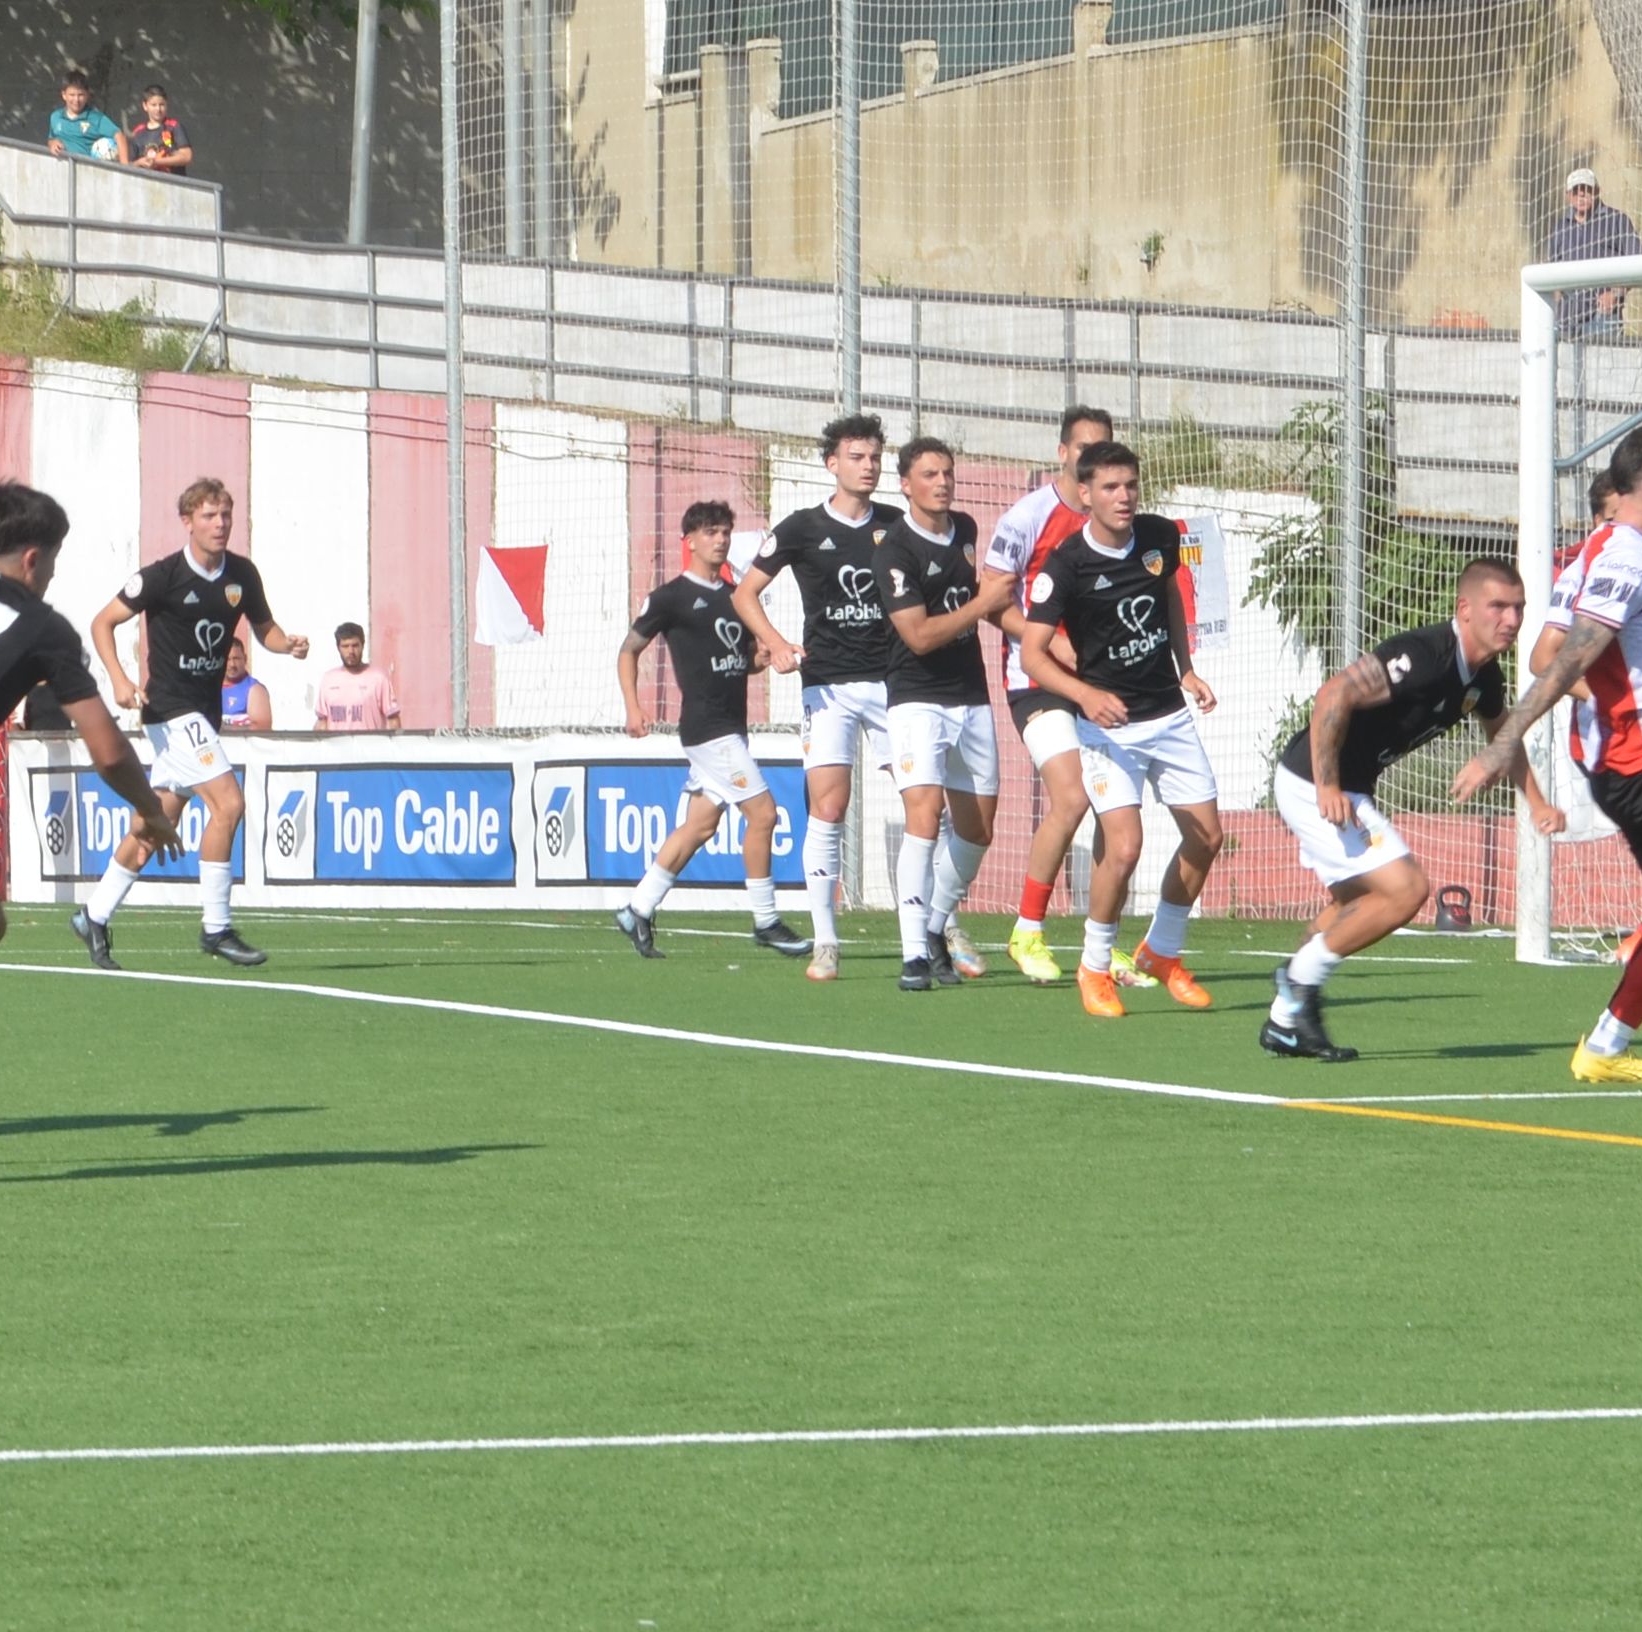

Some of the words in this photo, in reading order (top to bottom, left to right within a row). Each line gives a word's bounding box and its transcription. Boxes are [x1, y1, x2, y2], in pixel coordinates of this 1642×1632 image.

[184, 721, 208, 748] 12
[327, 791, 383, 870] Top
[395, 789, 499, 855] Cable
[598, 787, 667, 872] Top
